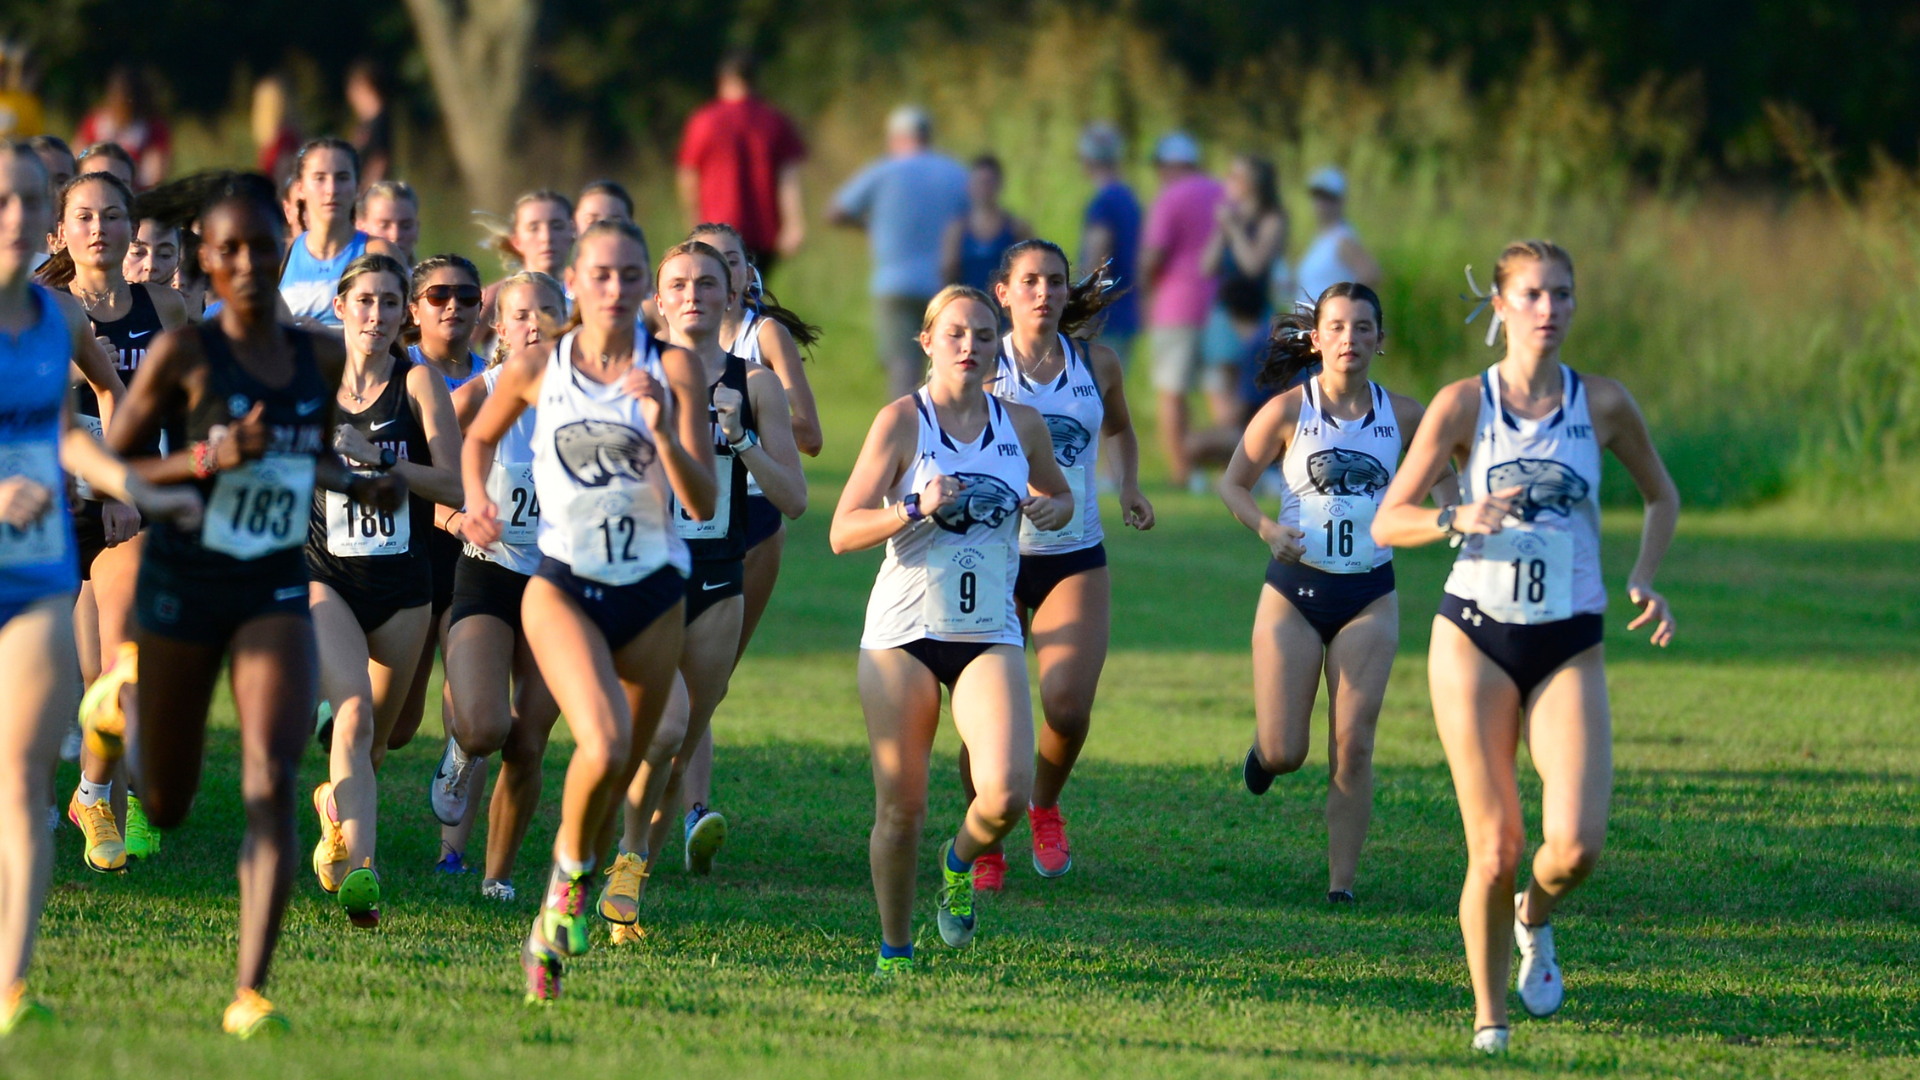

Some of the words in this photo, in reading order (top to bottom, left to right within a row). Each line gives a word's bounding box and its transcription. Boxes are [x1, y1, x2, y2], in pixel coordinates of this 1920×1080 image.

[1072, 385, 1096, 397] PBC
[997, 443, 1020, 457] PBC
[1373, 426, 1395, 438] PBC
[1566, 424, 1592, 440] PBC
[231, 486, 296, 539] 183
[343, 498, 396, 538] 186
[511, 487, 541, 527] 24
[599, 516, 639, 564] 12
[952, 551, 961, 562] EYE
[963, 547, 985, 560] OPENER
[1323, 519, 1353, 557] 16
[960, 571, 977, 615] 9
[1511, 557, 1546, 603] 18
